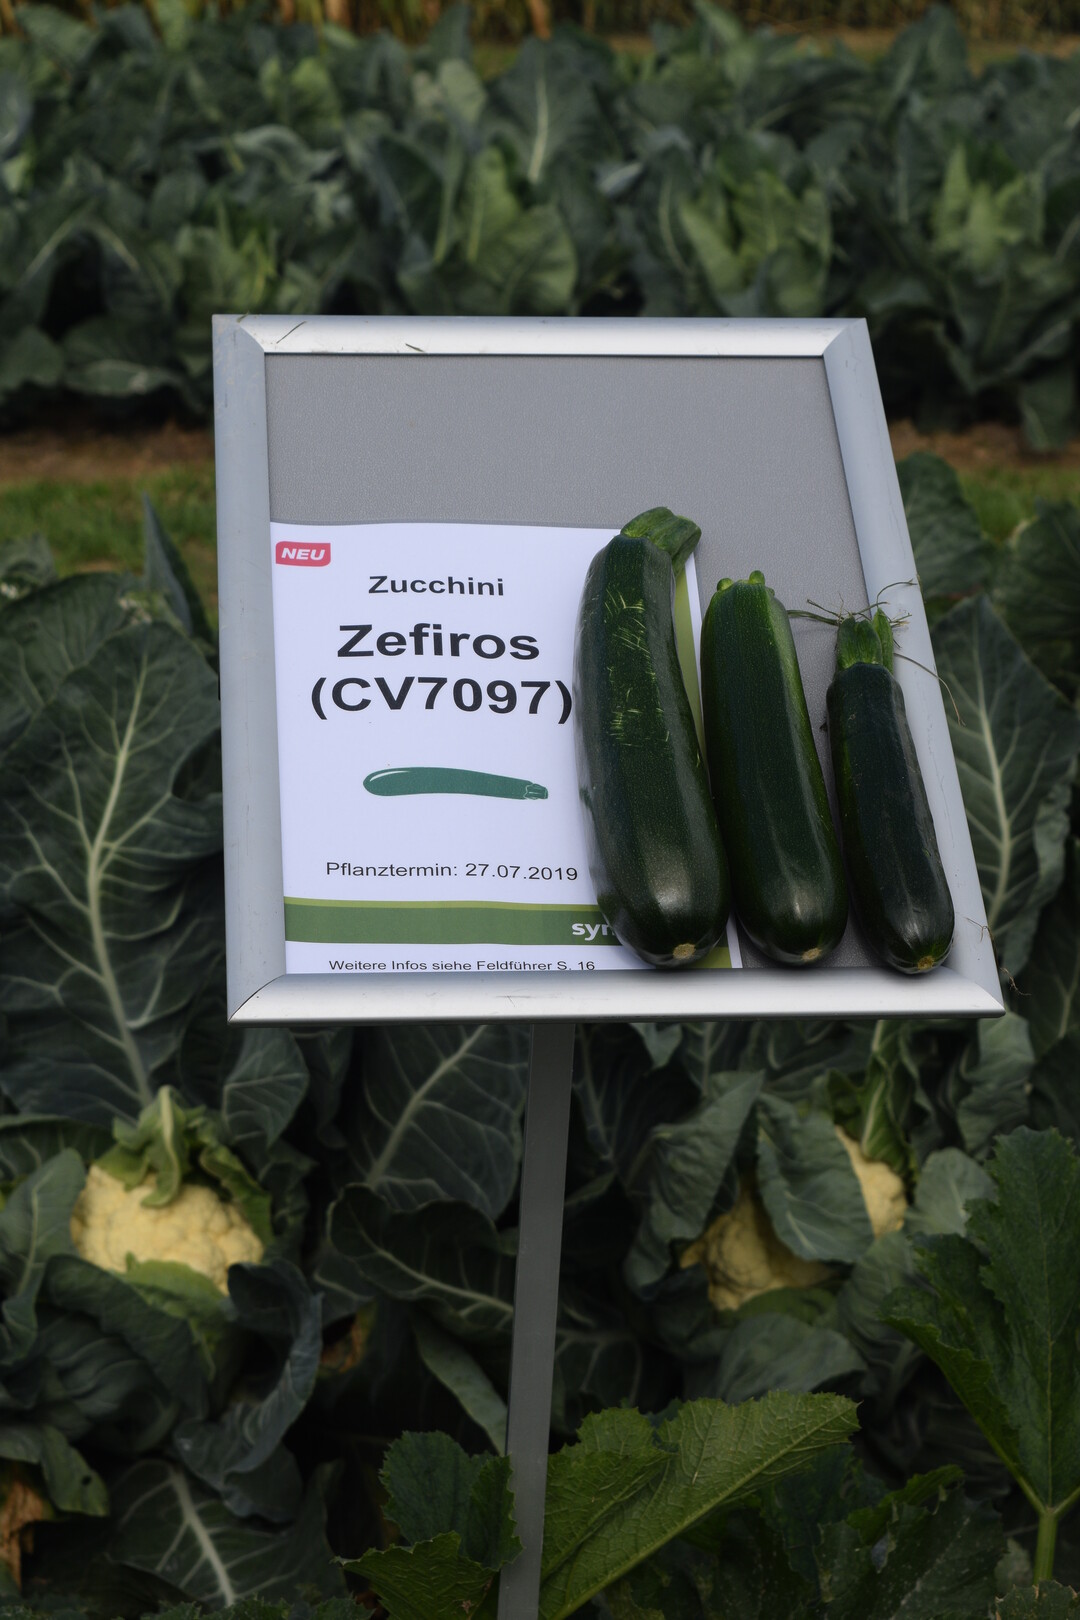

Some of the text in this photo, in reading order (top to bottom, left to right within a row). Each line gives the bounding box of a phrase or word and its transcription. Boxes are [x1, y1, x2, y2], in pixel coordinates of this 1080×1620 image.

[281, 547, 326, 561] NEU
[368, 576, 504, 596] Zucchini
[338, 622, 540, 660] Zefiros
[312, 676, 573, 725] (CV7097)
[326, 861, 578, 881] Pflanztermin: 27.07.2019
[328, 960, 596, 971] Weitere Infos siehe Feldführer S. 16
